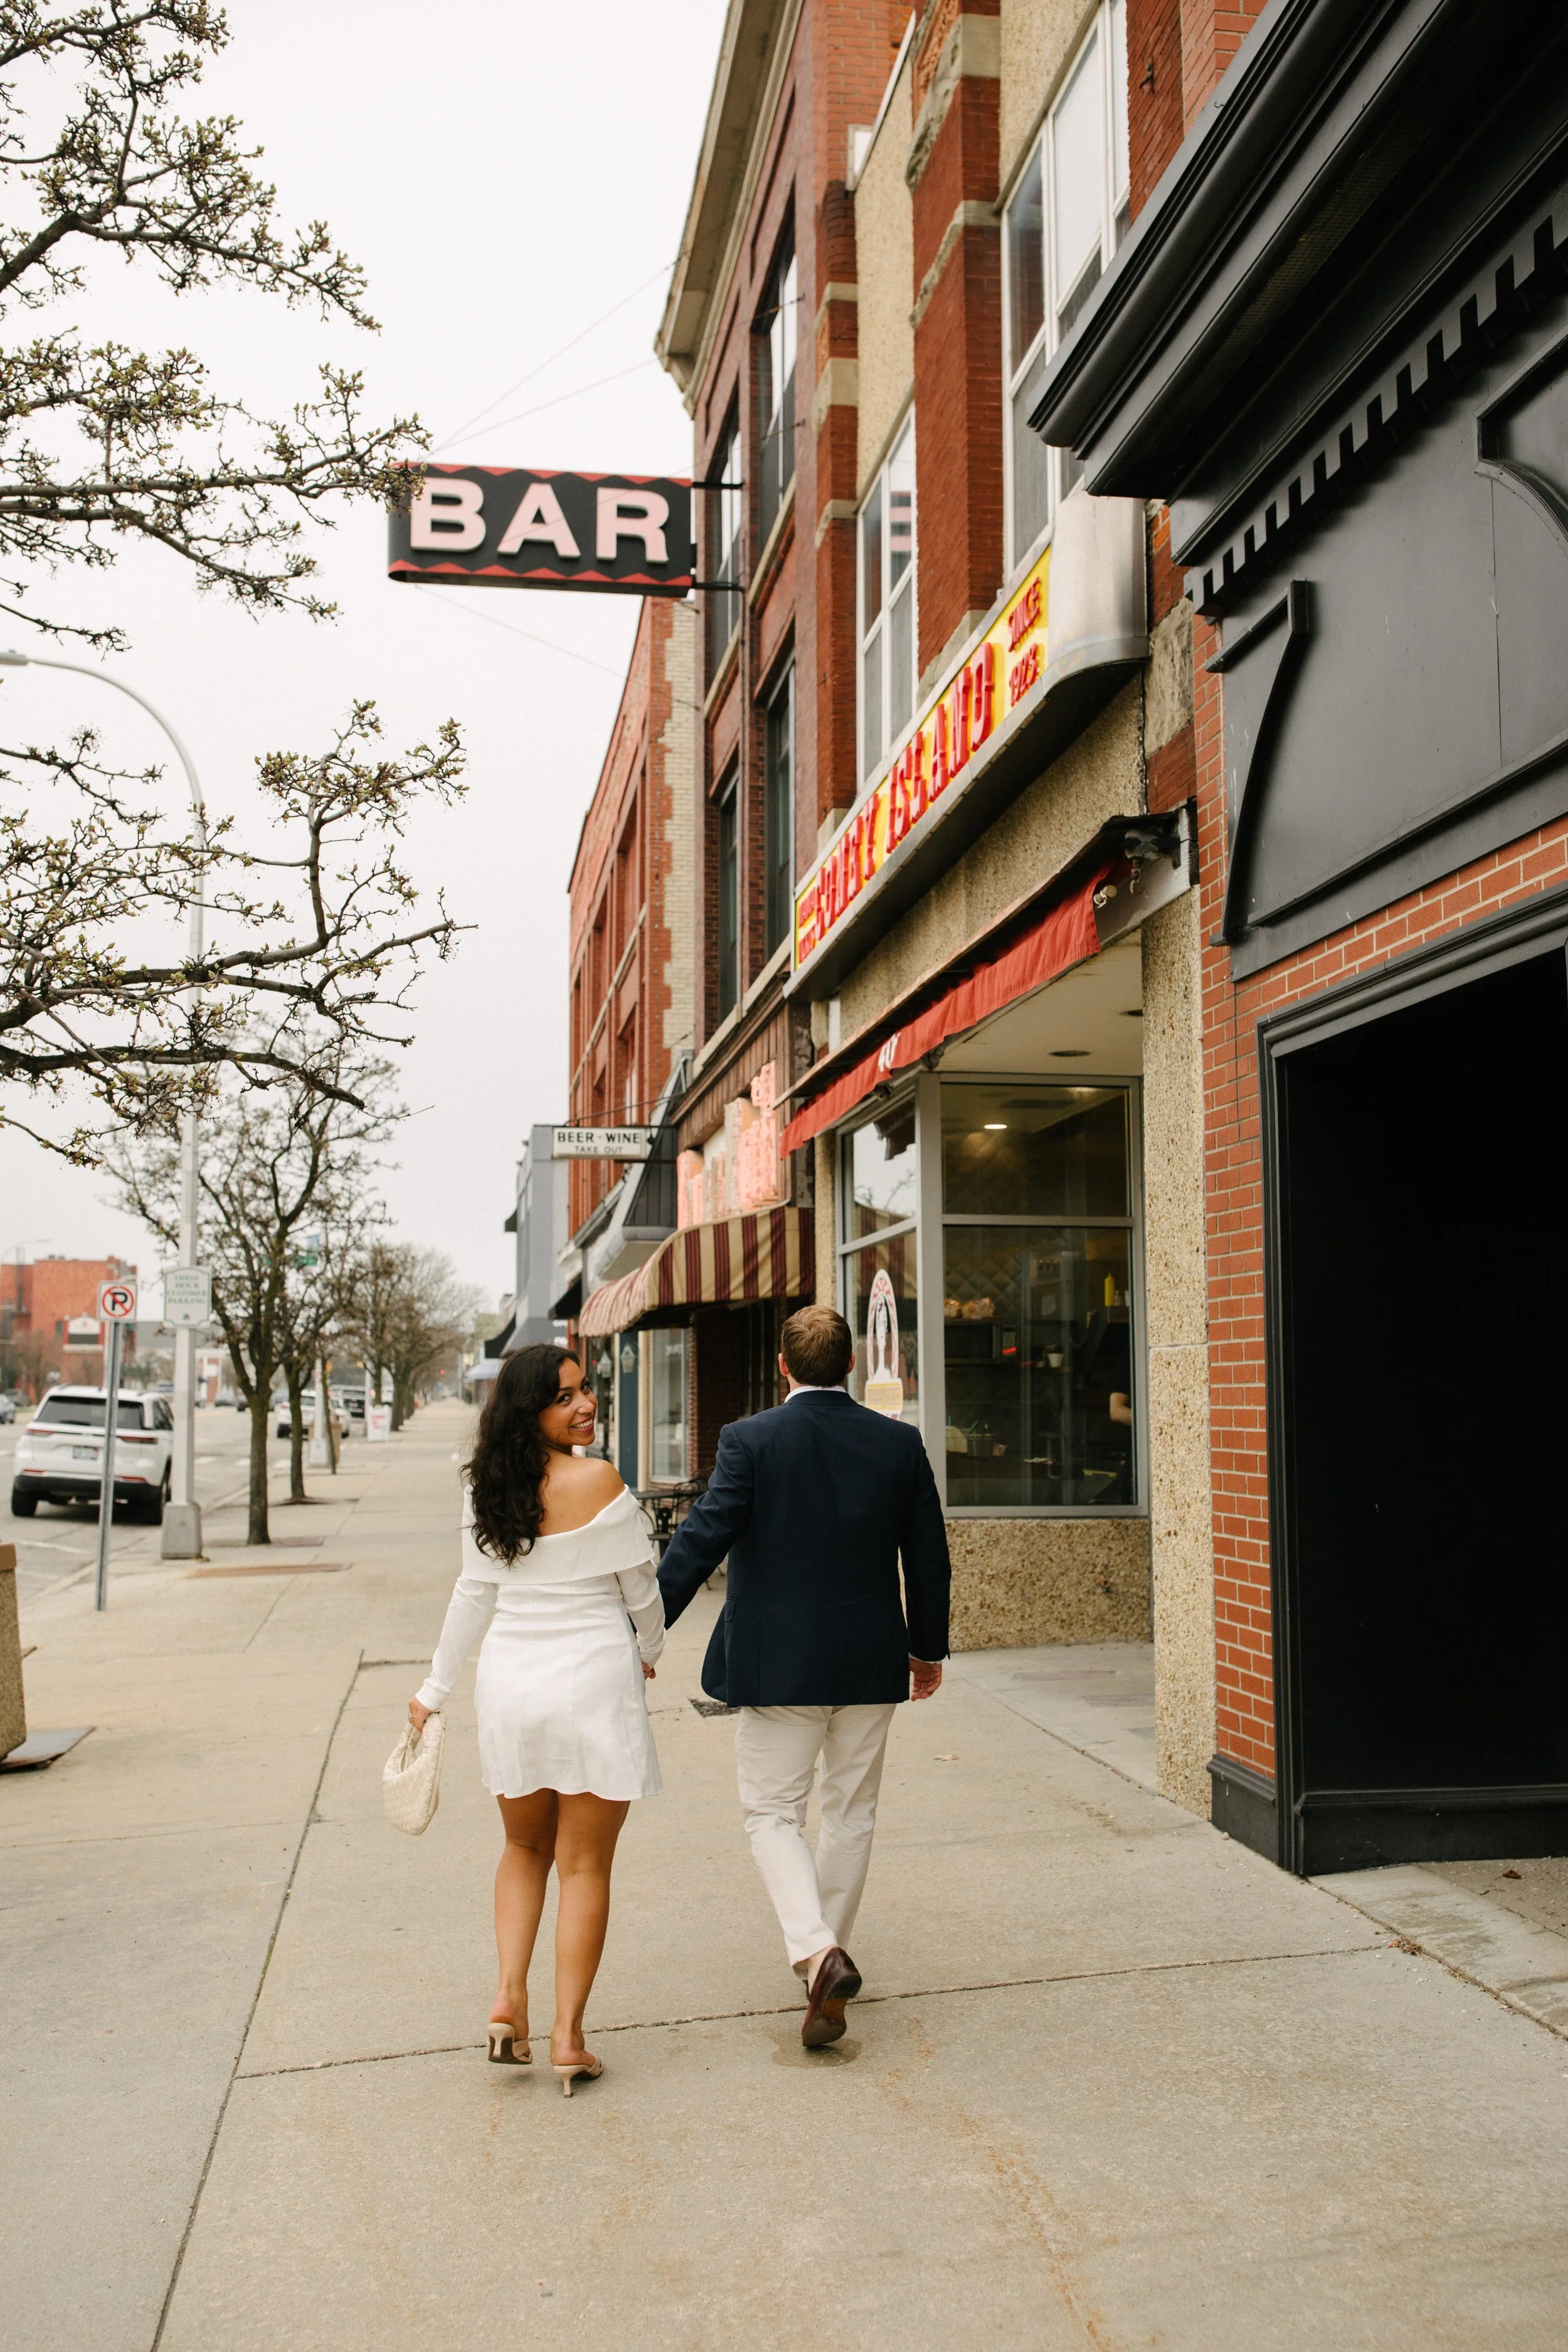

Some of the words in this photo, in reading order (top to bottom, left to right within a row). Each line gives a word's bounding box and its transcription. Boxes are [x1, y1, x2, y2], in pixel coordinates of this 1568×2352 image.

[411, 477, 669, 563] BAR
[1008, 576, 1041, 652] SINCE
[816, 793, 879, 941] CONEY
[886, 642, 993, 854] ISLAND
[558, 1131, 594, 1143] BEER
[606, 1132, 640, 1143] WINE
[575, 1145, 598, 1154] TAKE
[604, 1146, 623, 1154] OUT
